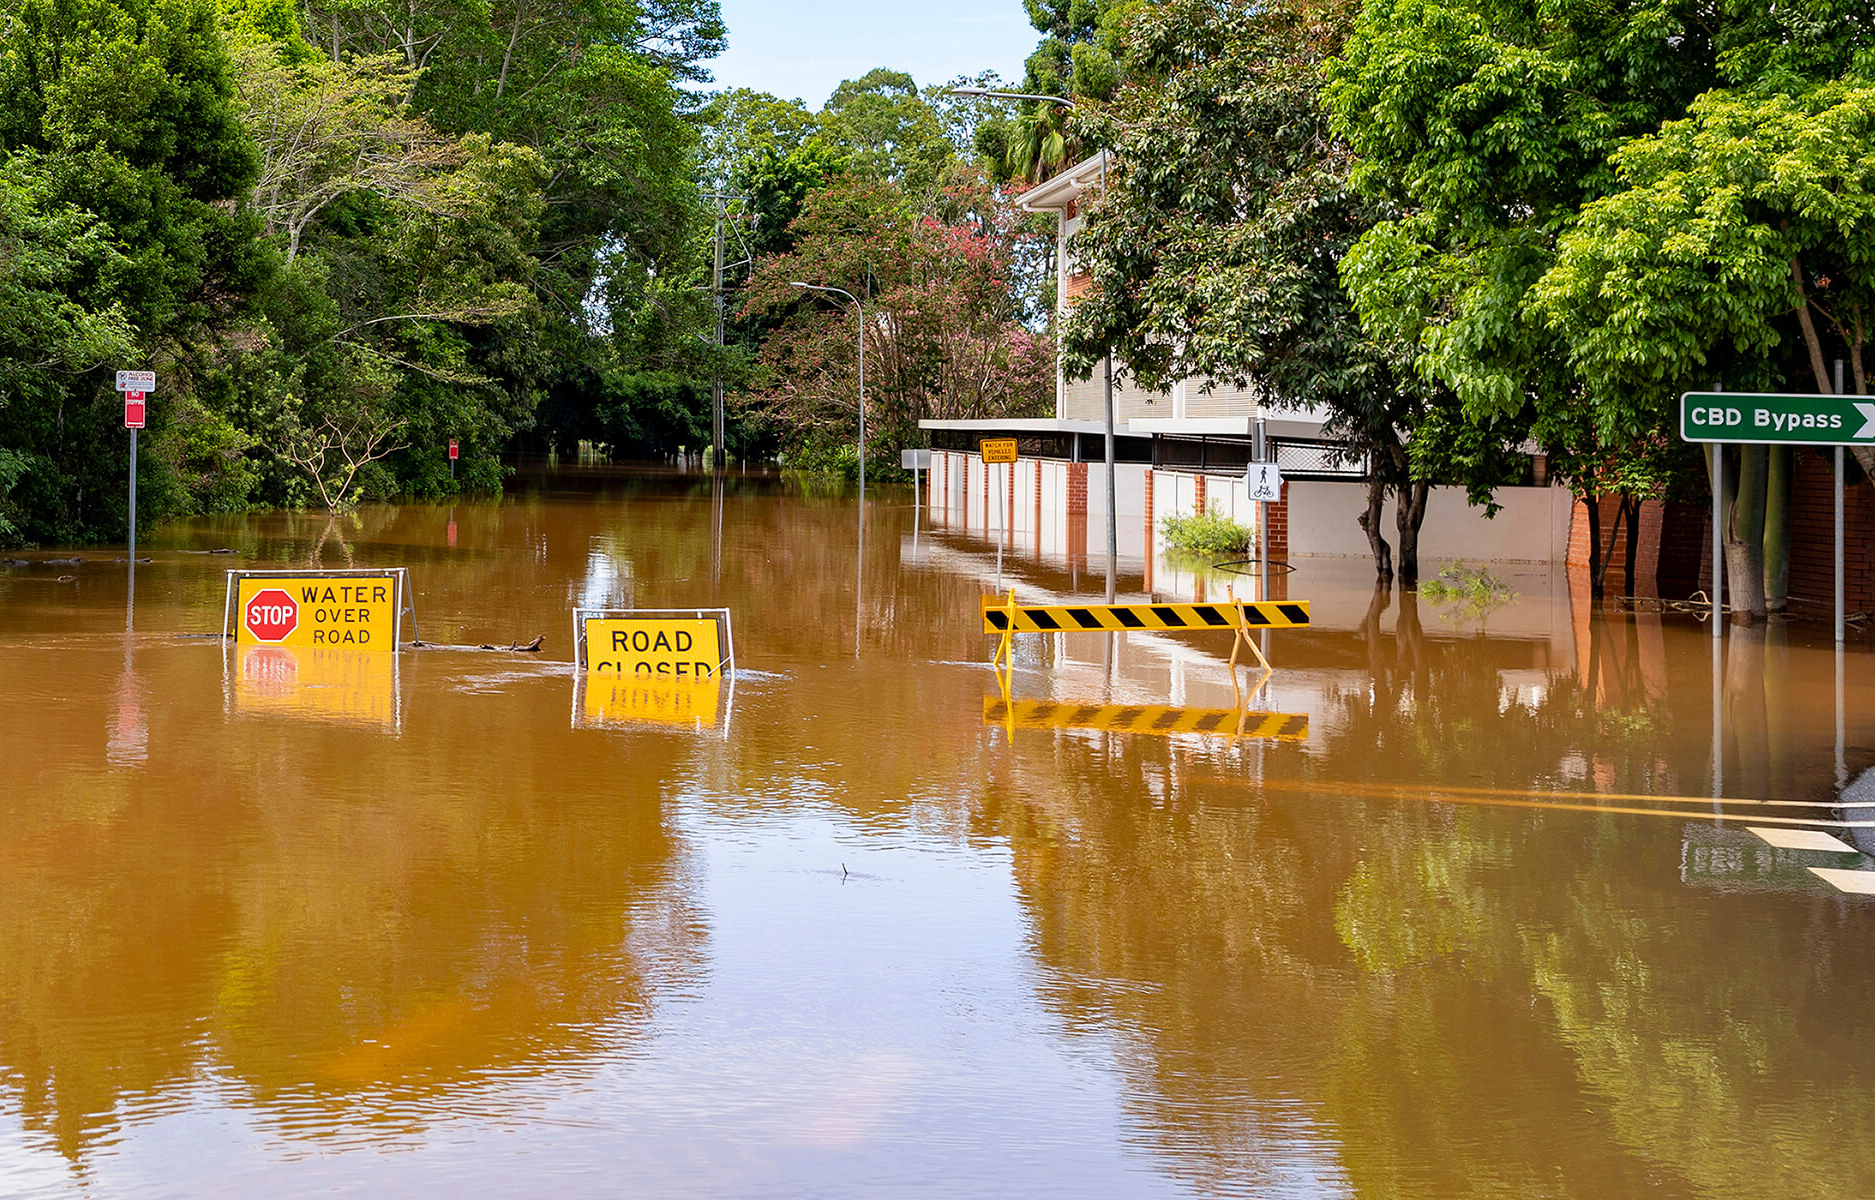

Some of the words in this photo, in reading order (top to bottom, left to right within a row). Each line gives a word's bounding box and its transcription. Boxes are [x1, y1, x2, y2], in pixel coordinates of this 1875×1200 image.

[1691, 407, 1742, 426] CBD
[1754, 409, 1842, 432] Bypass
[302, 587, 386, 603] WATER
[250, 606, 293, 625] STOP
[315, 609, 370, 622] OVER
[314, 630, 370, 644] ROAD
[612, 631, 692, 652] ROAD
